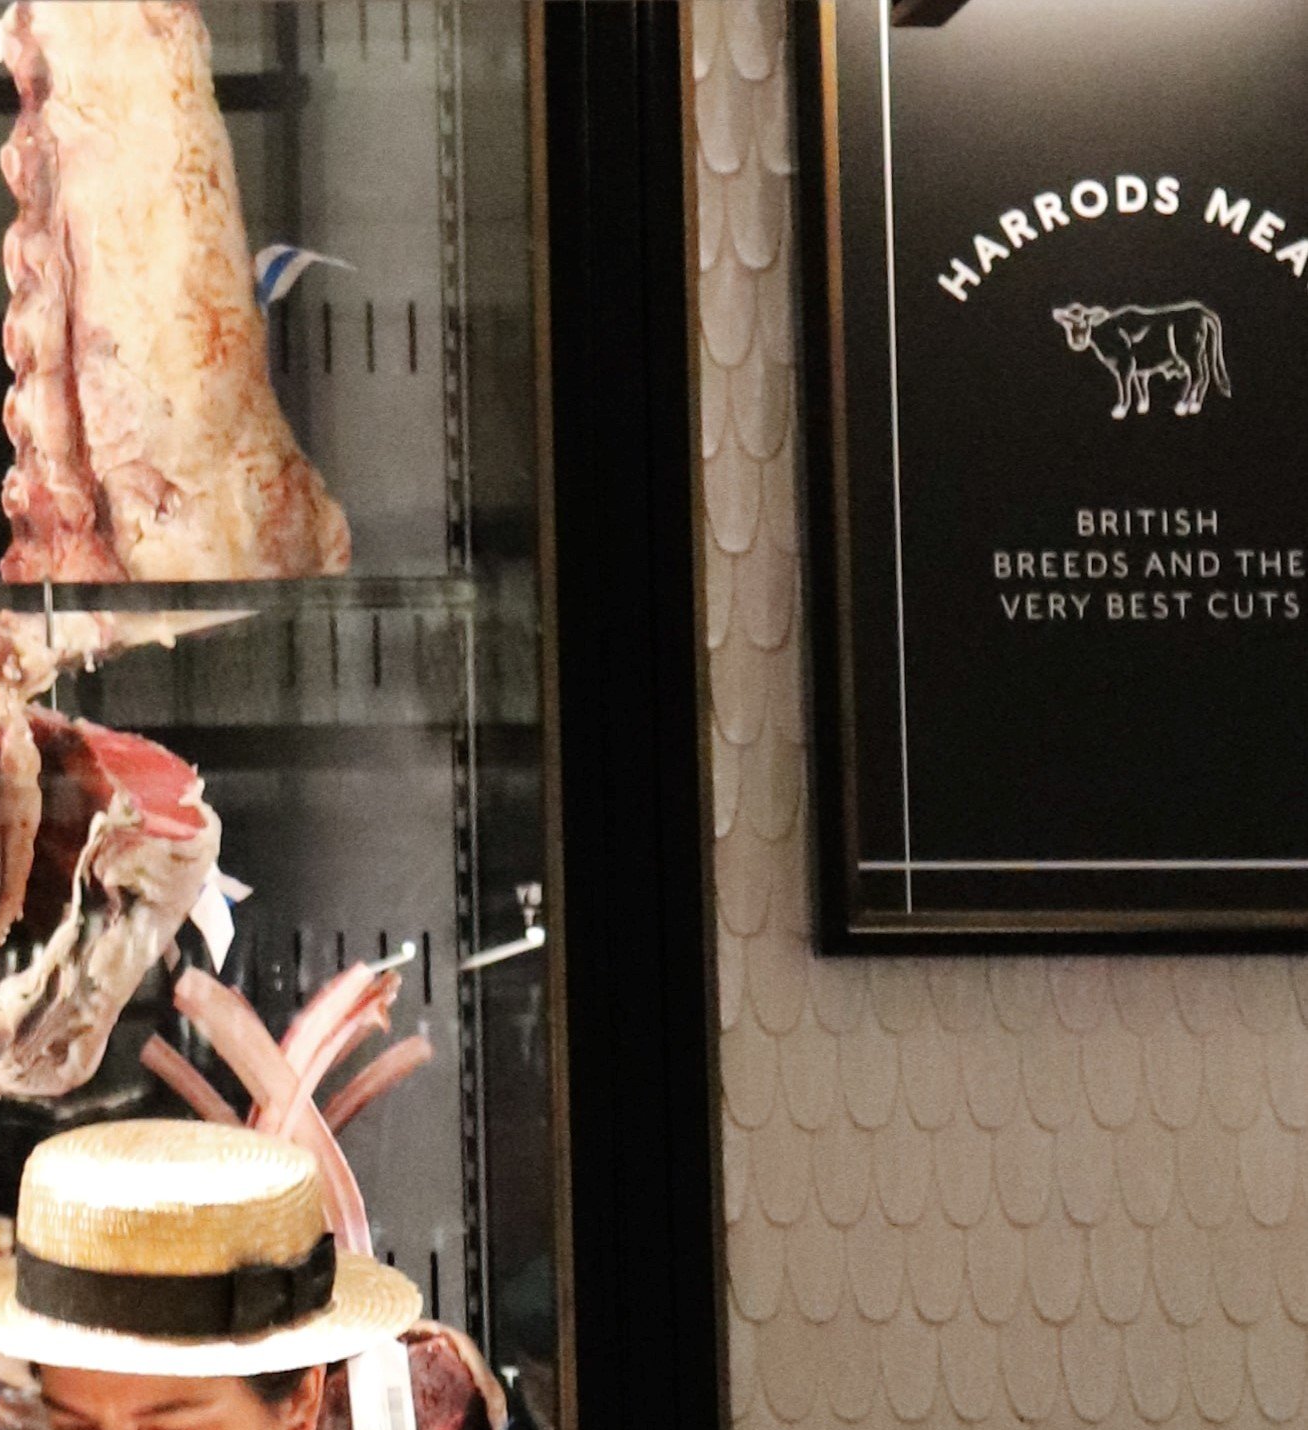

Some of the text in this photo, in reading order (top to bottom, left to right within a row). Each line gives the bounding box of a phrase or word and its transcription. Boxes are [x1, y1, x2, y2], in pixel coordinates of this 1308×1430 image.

[938, 174, 1308, 300] HARRODS MEA
[1077, 509, 1219, 536] BRITISH
[993, 549, 1305, 579] BREEDS AND THE
[1000, 592, 1301, 620] VERY BEST CUTS
